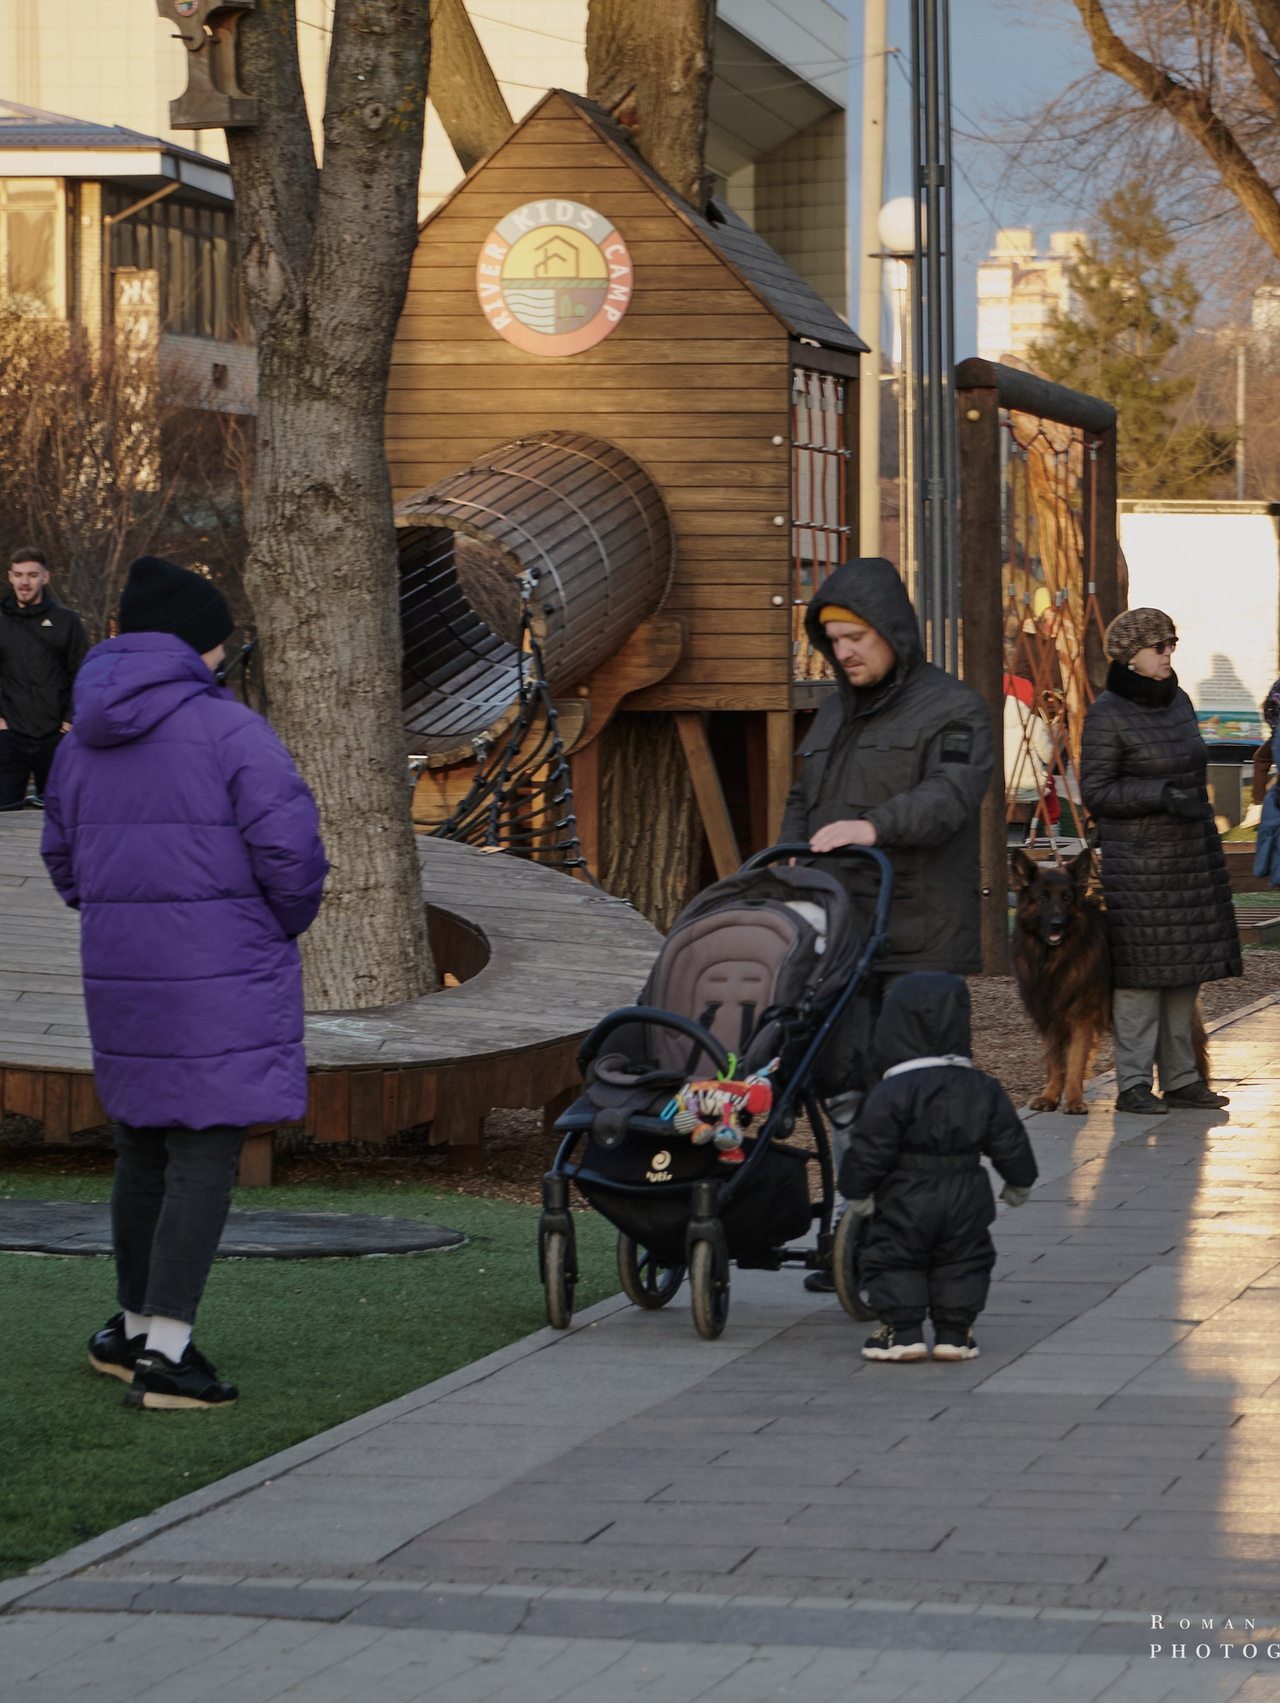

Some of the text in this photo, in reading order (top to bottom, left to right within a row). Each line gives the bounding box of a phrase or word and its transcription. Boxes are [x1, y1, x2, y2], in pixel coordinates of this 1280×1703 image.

[511, 201, 598, 232] KIDS
[480, 243, 513, 331] RIVER
[603, 243, 630, 323] CAMP
